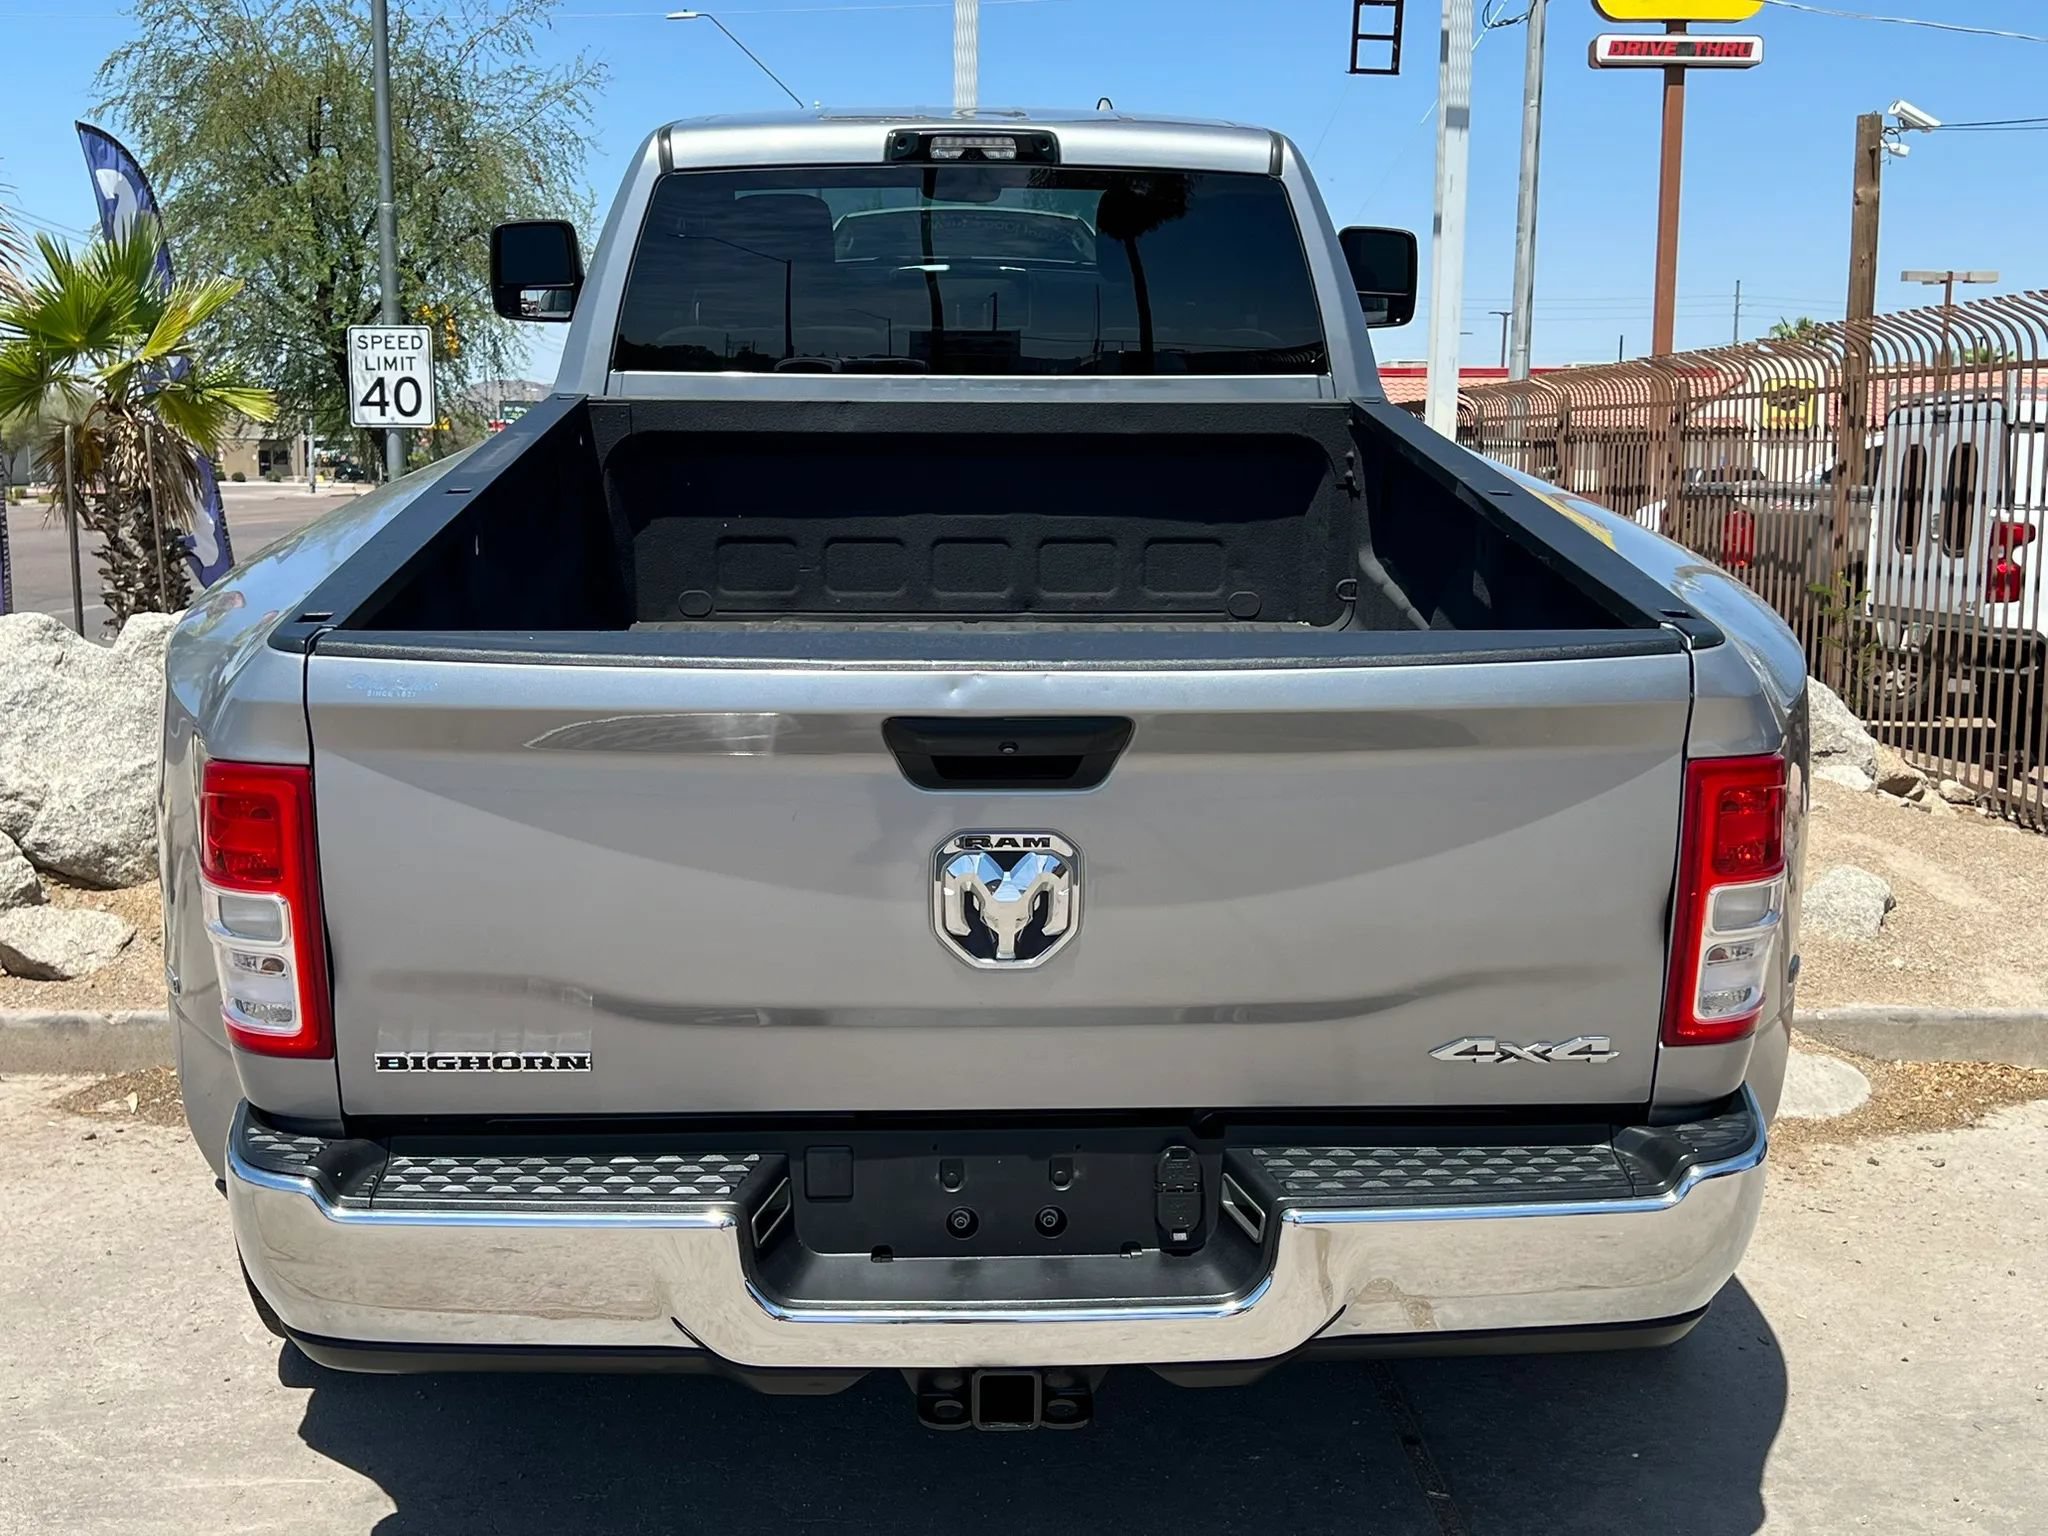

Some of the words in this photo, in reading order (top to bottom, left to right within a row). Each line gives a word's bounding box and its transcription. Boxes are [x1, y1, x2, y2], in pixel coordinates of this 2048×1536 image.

[1608, 41, 1678, 56] DRIVE
[1694, 42, 1754, 57] THRU
[357, 335, 423, 350] SPEED
[364, 356, 416, 371] LIMIT
[360, 376, 422, 417] 40
[962, 835, 1051, 850] RAM
[375, 1052, 591, 1072] BIGHORN
